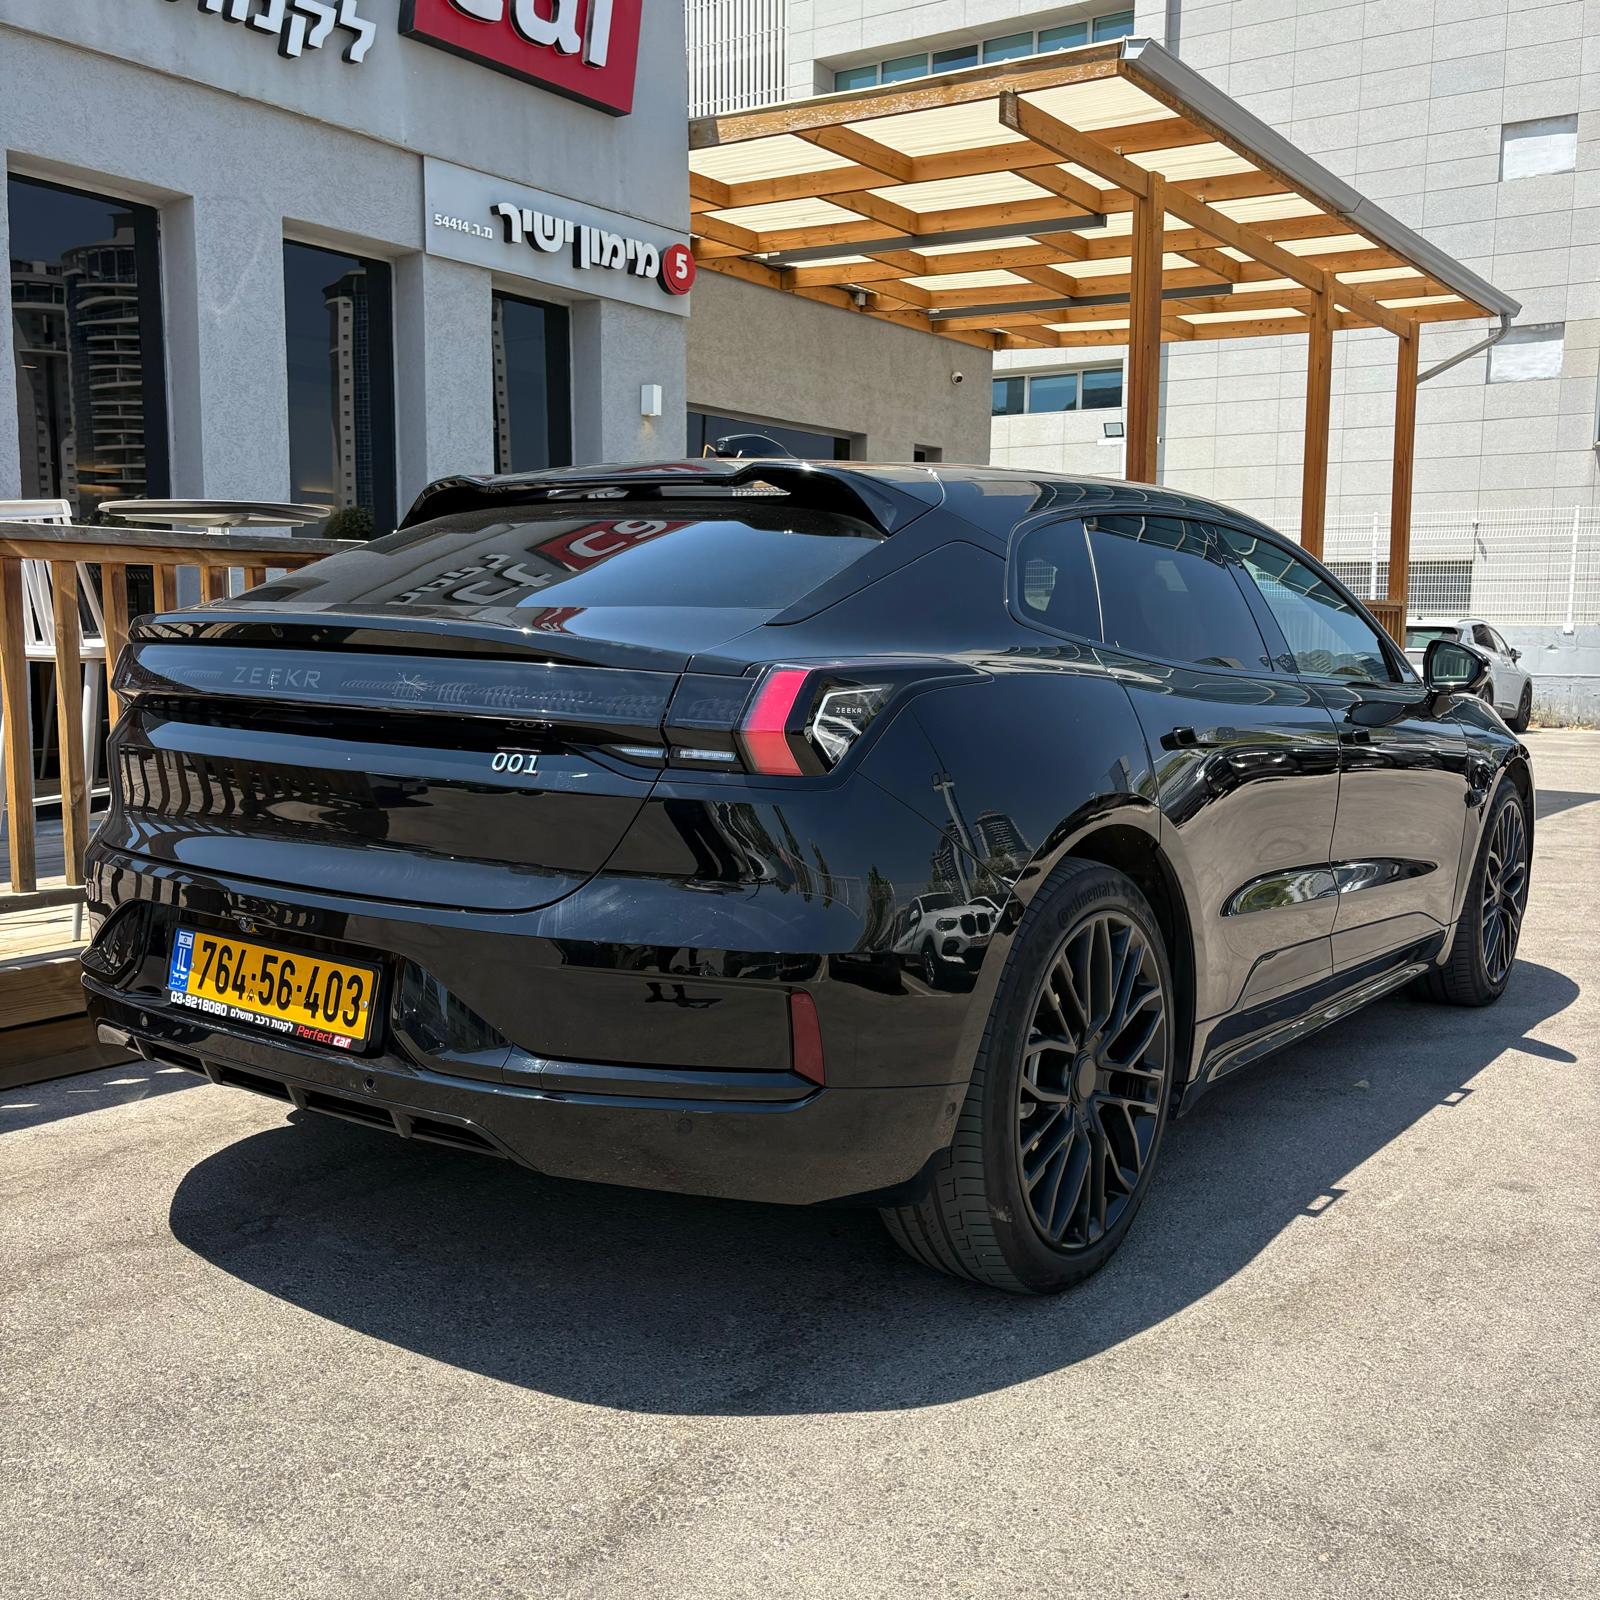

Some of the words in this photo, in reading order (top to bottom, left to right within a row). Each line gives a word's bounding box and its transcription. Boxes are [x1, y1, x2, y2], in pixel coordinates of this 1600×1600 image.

[434, 213, 469, 233] 54414
[491, 202, 574, 253] ישיר
[572, 224, 660, 279] מימון
[675, 253, 688, 280] 5
[231, 665, 321, 690] ZEEKR
[491, 752, 538, 774] 001
[170, 991, 227, 1016] 03-9218080
[255, 1014, 270, 1026] רכב
[271, 1020, 293, 1033] לקנות
[296, 1025, 332, 1044] Perfect
[333, 1037, 352, 1049] car
